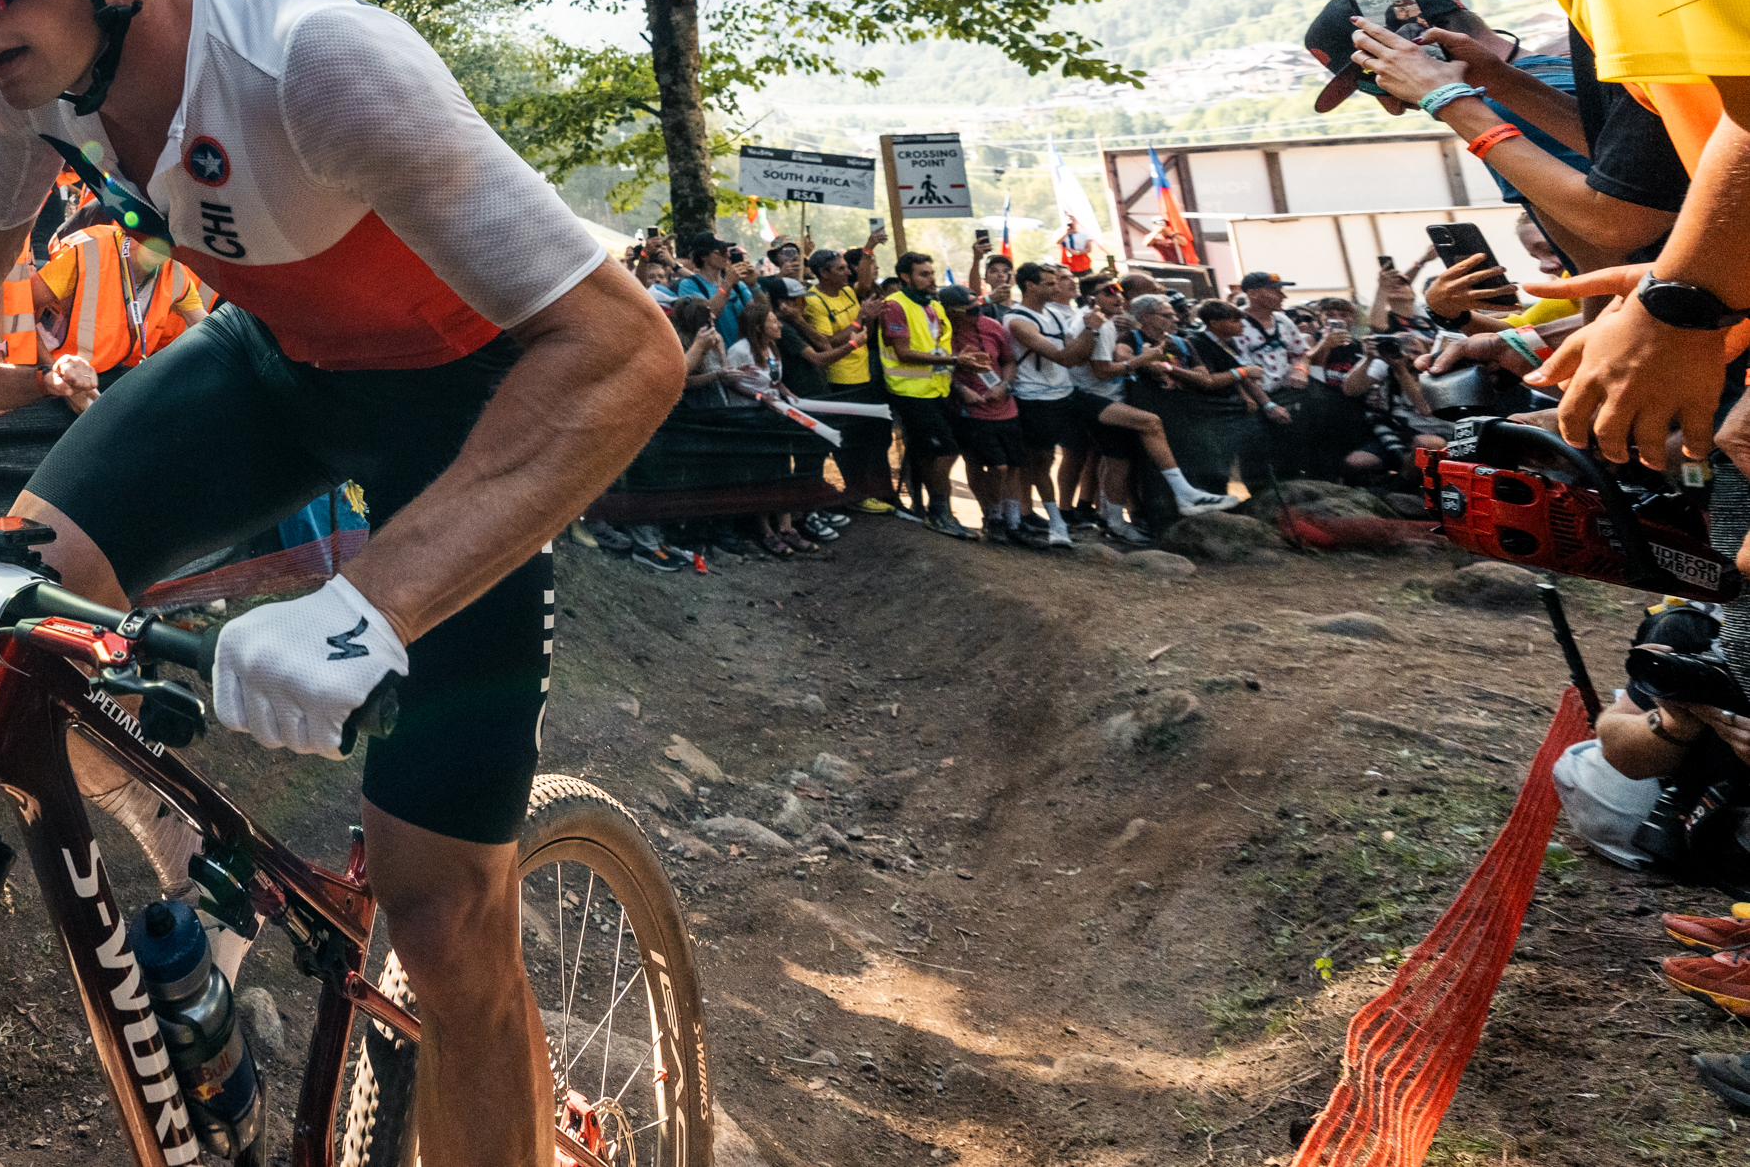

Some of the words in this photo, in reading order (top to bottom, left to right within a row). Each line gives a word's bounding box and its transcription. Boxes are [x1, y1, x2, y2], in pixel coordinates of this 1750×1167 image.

[898, 149, 958, 160] CROSSING
[911, 158, 946, 168] POINT
[762, 169, 804, 183] SOUTH
[806, 175, 851, 188] AFRICA
[792, 190, 818, 202] RSA
[200, 201, 246, 259] CHI
[200, 1051, 232, 1084] Bull
[693, 1021, 710, 1122] S-WORKS
